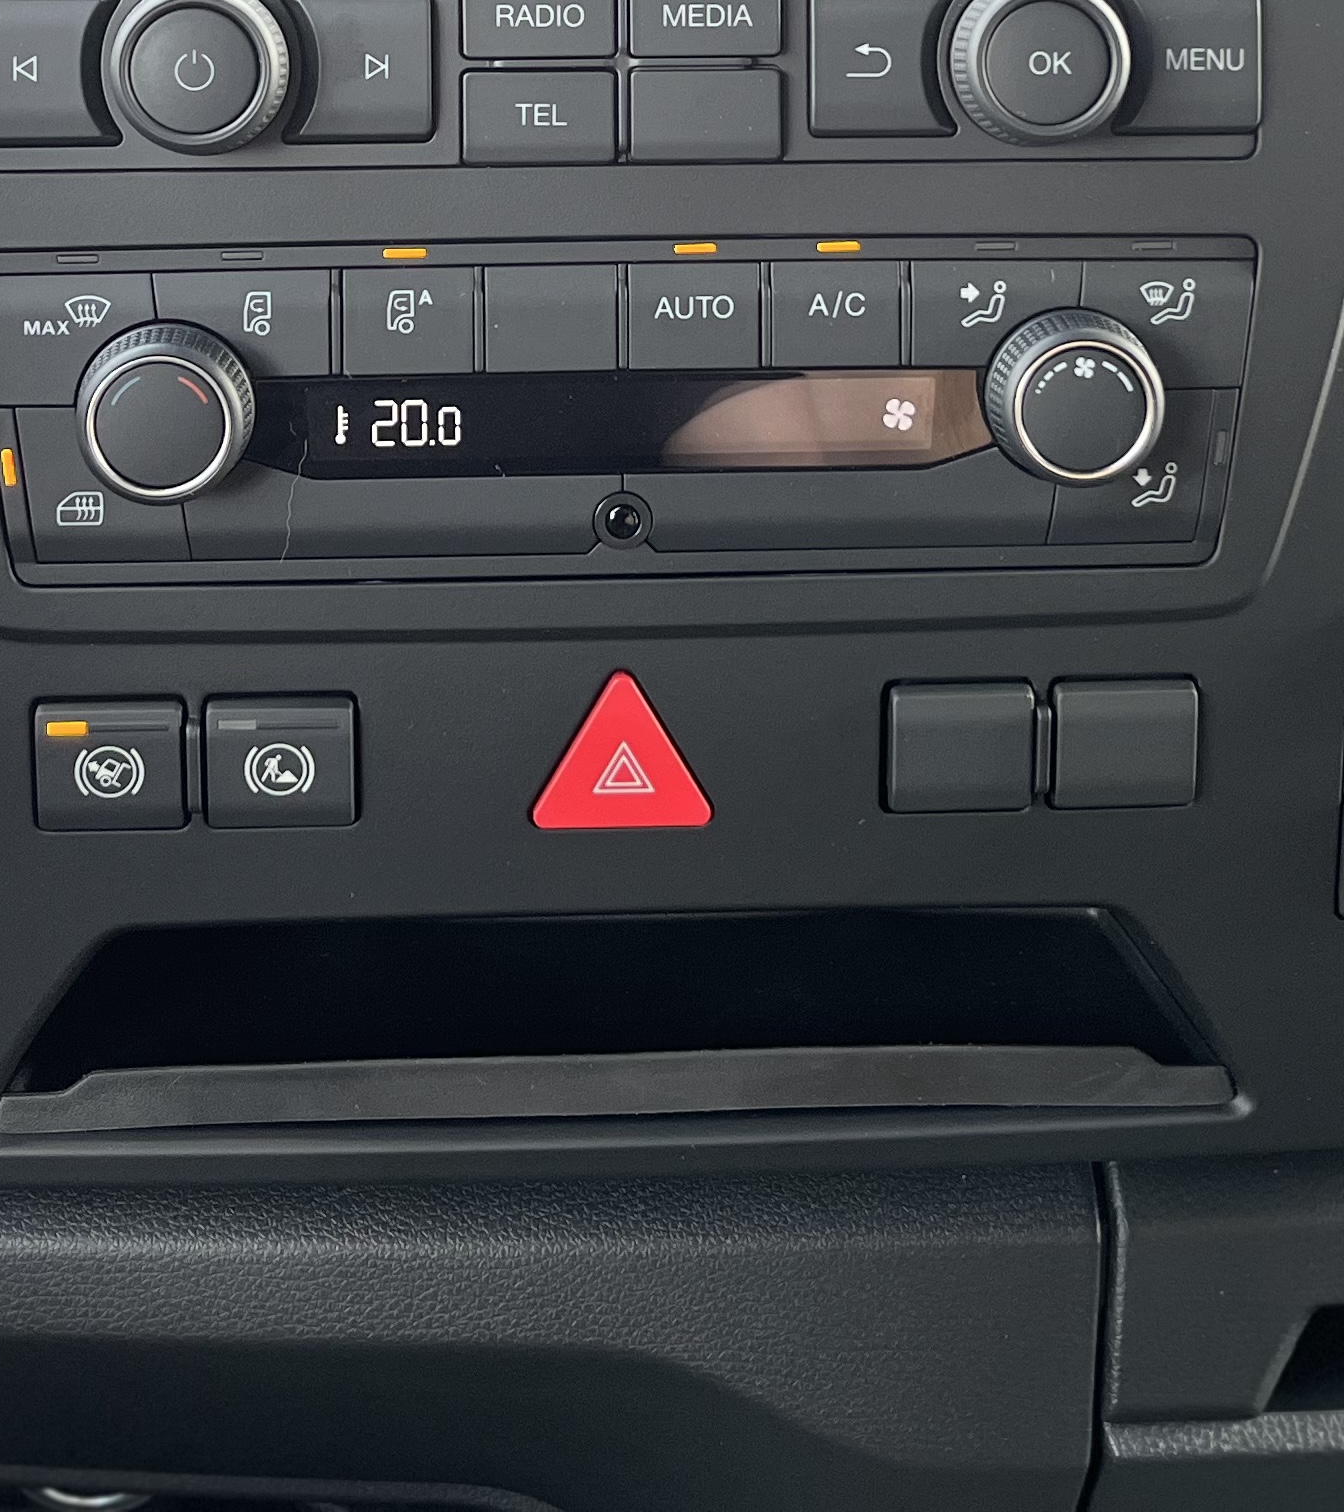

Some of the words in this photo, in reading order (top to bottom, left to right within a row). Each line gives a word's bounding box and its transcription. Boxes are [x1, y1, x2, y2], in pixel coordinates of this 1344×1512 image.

[495, 3, 585, 28] RADIO
[662, 3, 753, 28] MEDIA
[1028, 50, 1072, 76] OK
[1166, 47, 1245, 72] MENU
[514, 103, 568, 126] TEL
[418, 289, 433, 306] A
[654, 295, 735, 320] AUTO
[808, 290, 866, 319] A/C
[23, 320, 71, 336] MAX
[371, 399, 462, 447] 20.0
